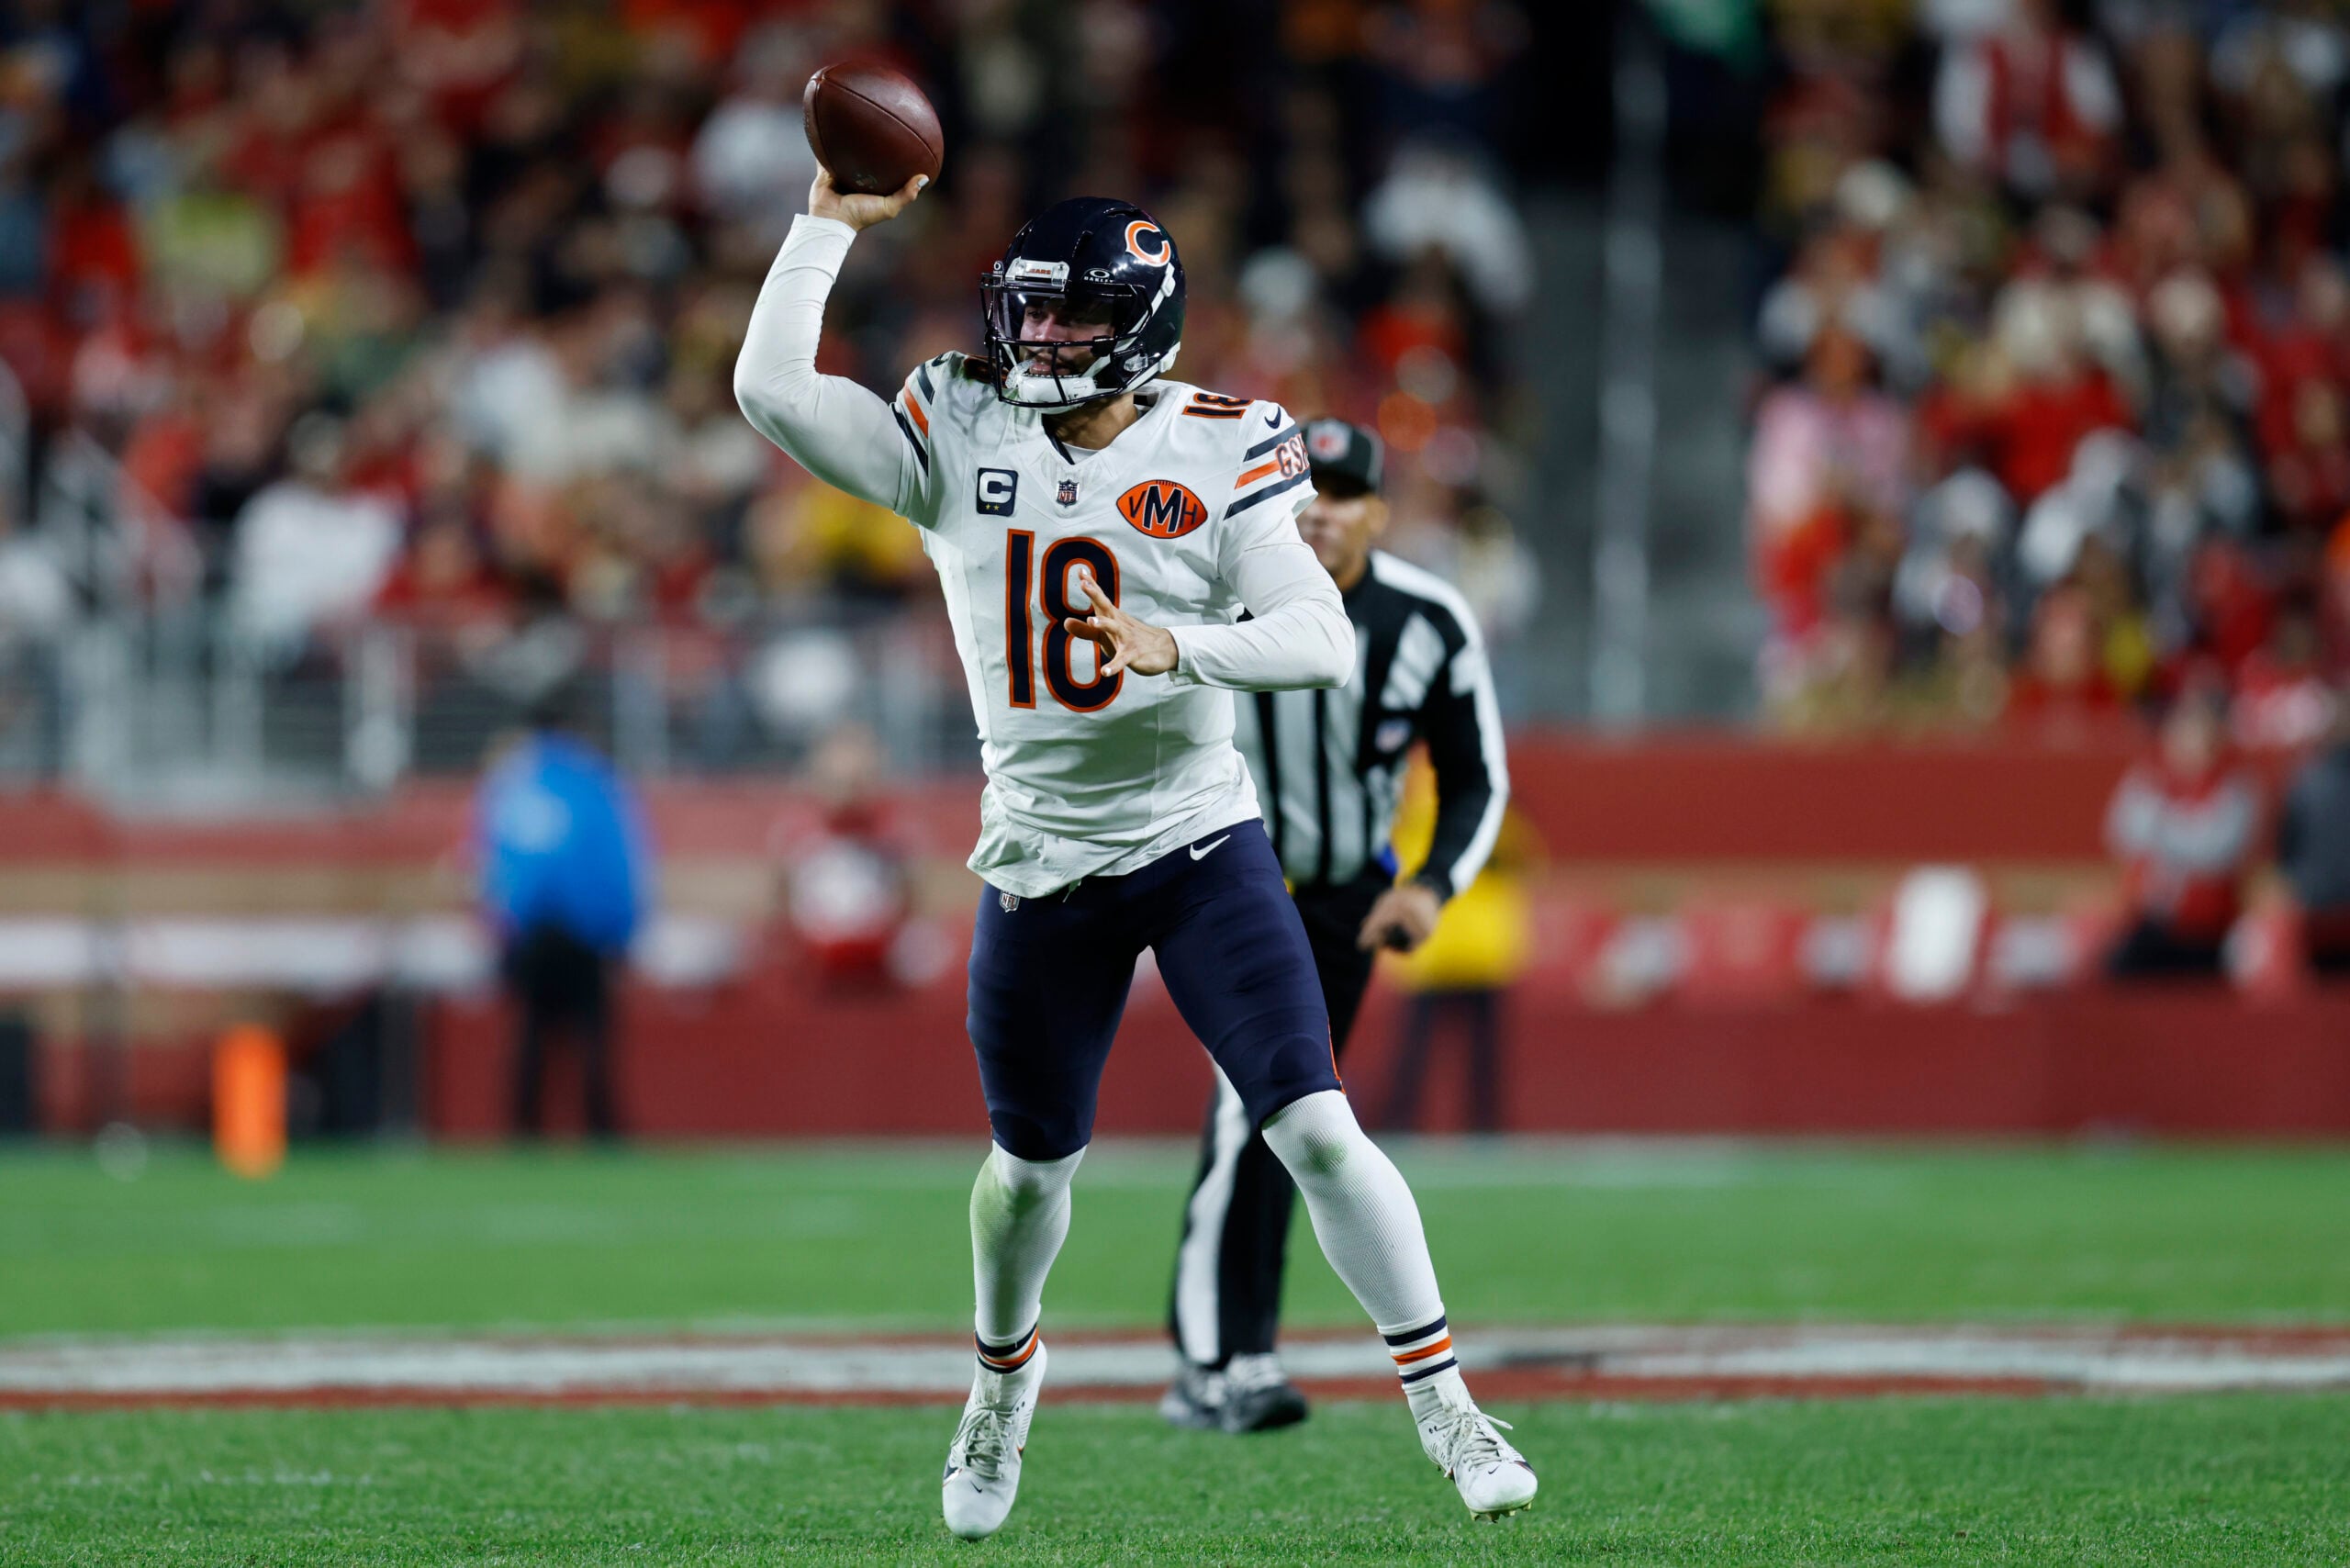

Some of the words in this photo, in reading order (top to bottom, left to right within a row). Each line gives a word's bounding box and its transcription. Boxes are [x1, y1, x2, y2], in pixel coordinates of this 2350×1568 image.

[1125, 220, 1171, 267] C
[979, 471, 1013, 504] C
[1128, 484, 1198, 534] VMH
[1005, 528, 1125, 713] 18
[1001, 893, 1017, 910] NFL
